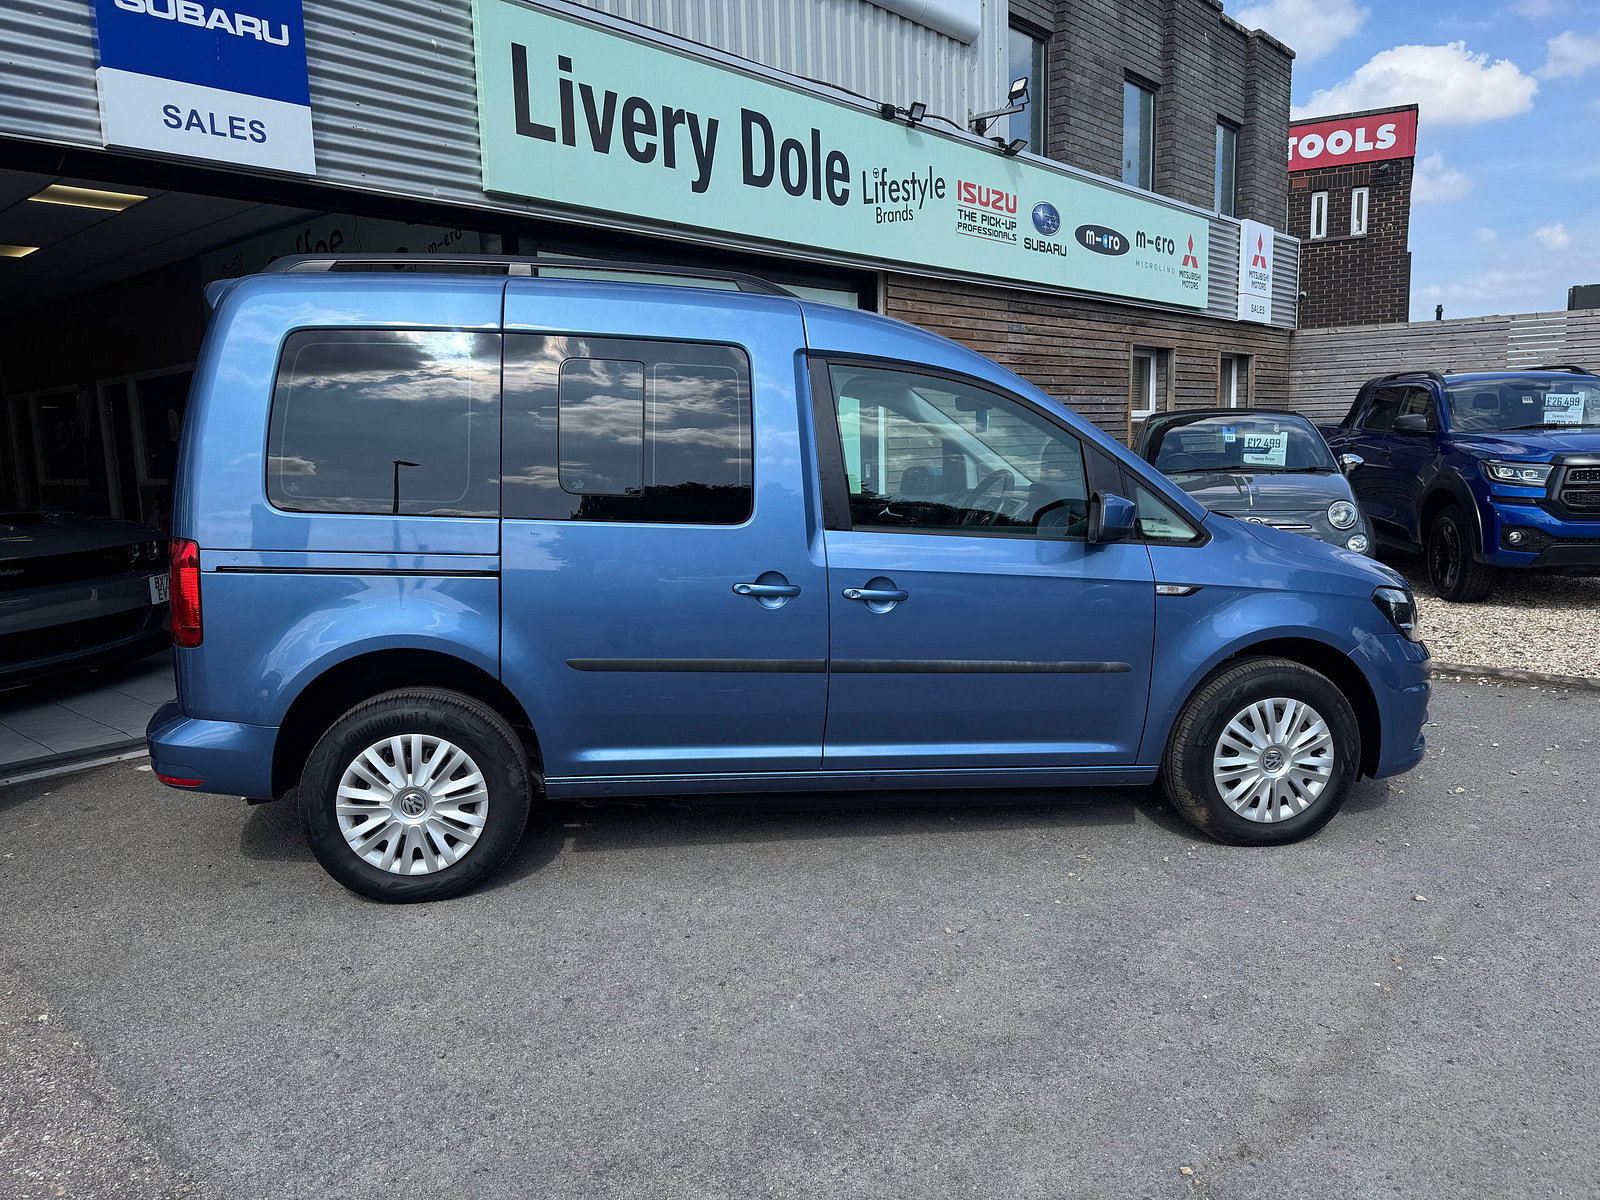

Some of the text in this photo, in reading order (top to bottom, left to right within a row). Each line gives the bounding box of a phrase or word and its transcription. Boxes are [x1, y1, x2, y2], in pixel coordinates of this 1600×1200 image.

[162, 104, 267, 144] SALES
[510, 41, 851, 207] Livery Dole
[862, 165, 946, 210] Lifestyle
[957, 179, 1018, 214] ISUZU
[876, 203, 914, 224] Brands
[957, 208, 1018, 231] THE PICK-UP
[957, 221, 1018, 242] PROFESSIONALS
[1023, 237, 1068, 257] SUBARU
[1135, 259, 1176, 275] MICROLINO
[1178, 269, 1202, 282] MITSUBISHI
[1181, 279, 1199, 290] MOTORS
[1250, 303, 1266, 315] SALES
